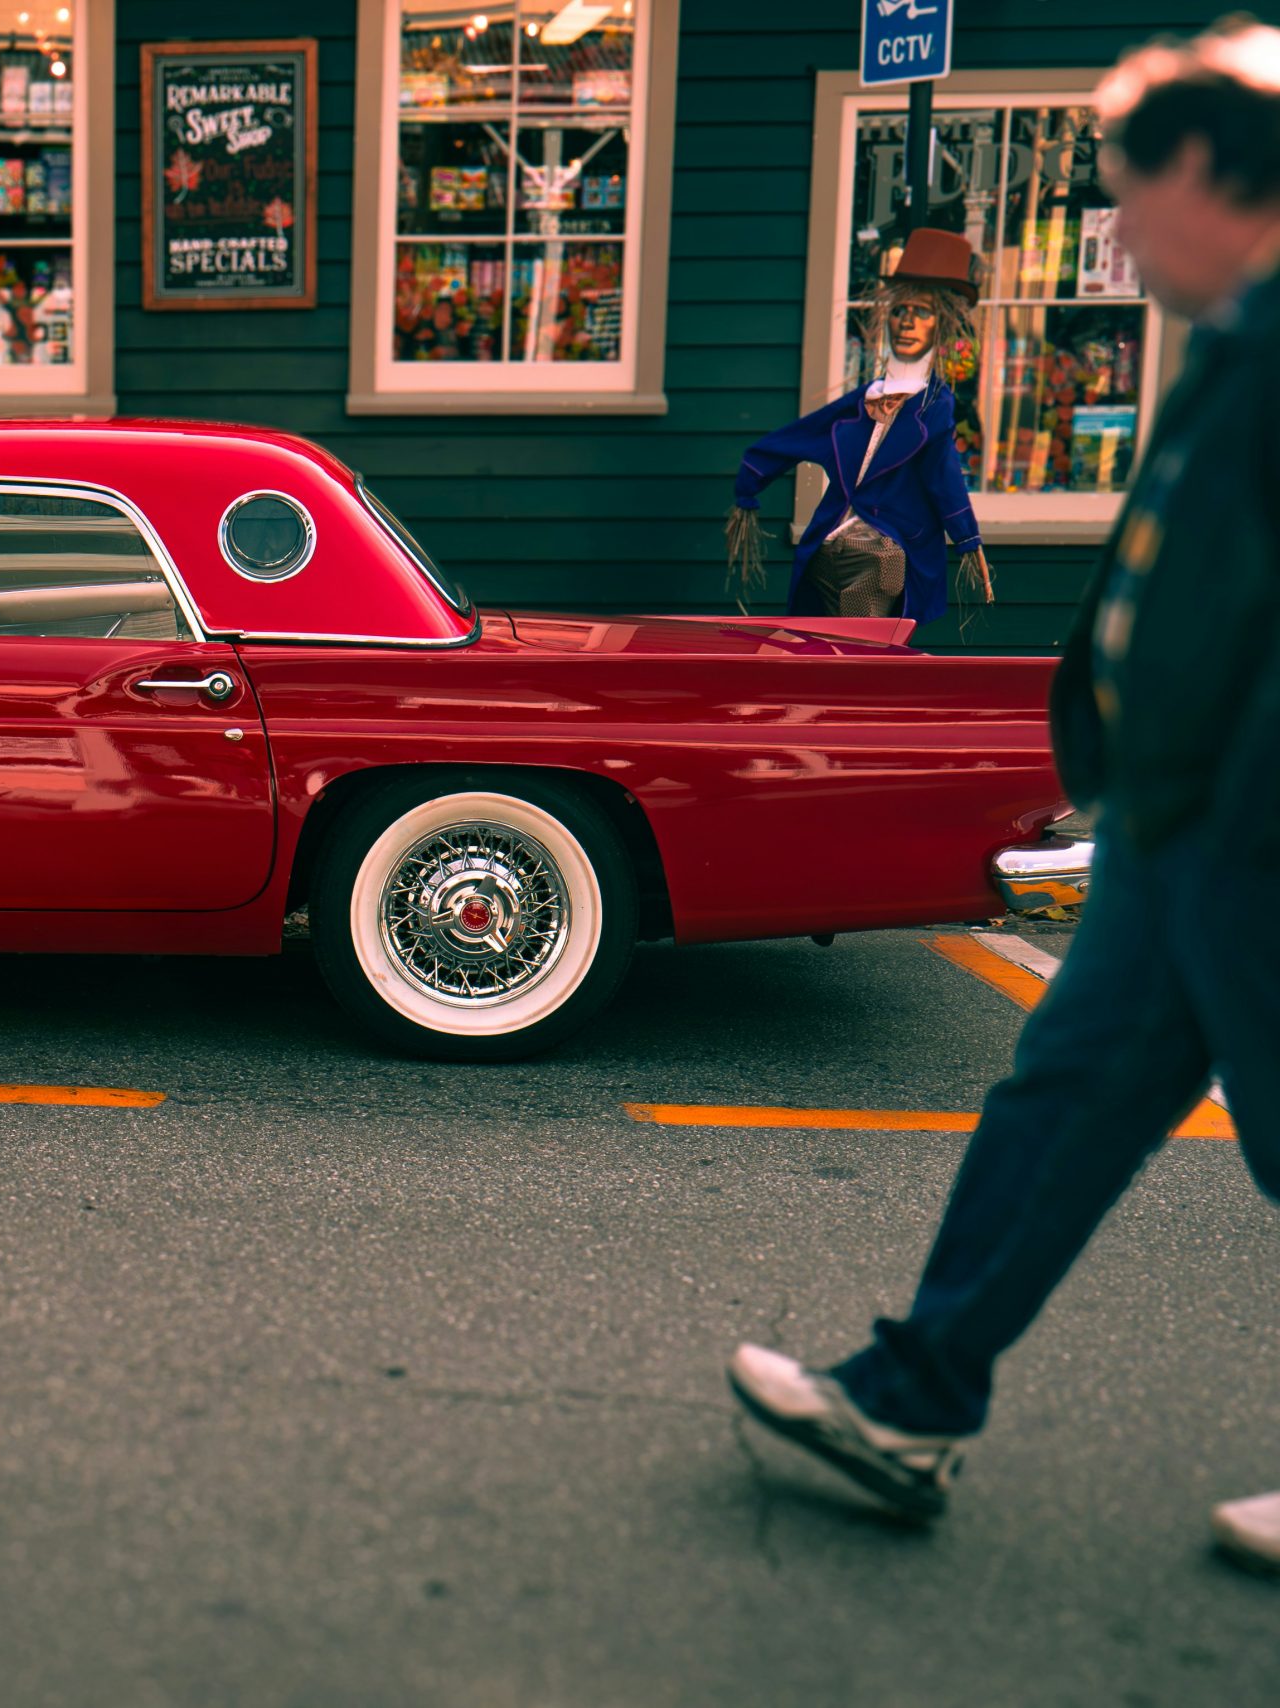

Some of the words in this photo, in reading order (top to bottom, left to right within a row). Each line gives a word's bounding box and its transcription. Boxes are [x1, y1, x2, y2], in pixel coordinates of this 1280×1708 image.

[878, 33, 933, 66] CCTV
[167, 83, 291, 113] REMARKABLE
[170, 249, 287, 273] SPECIALS
